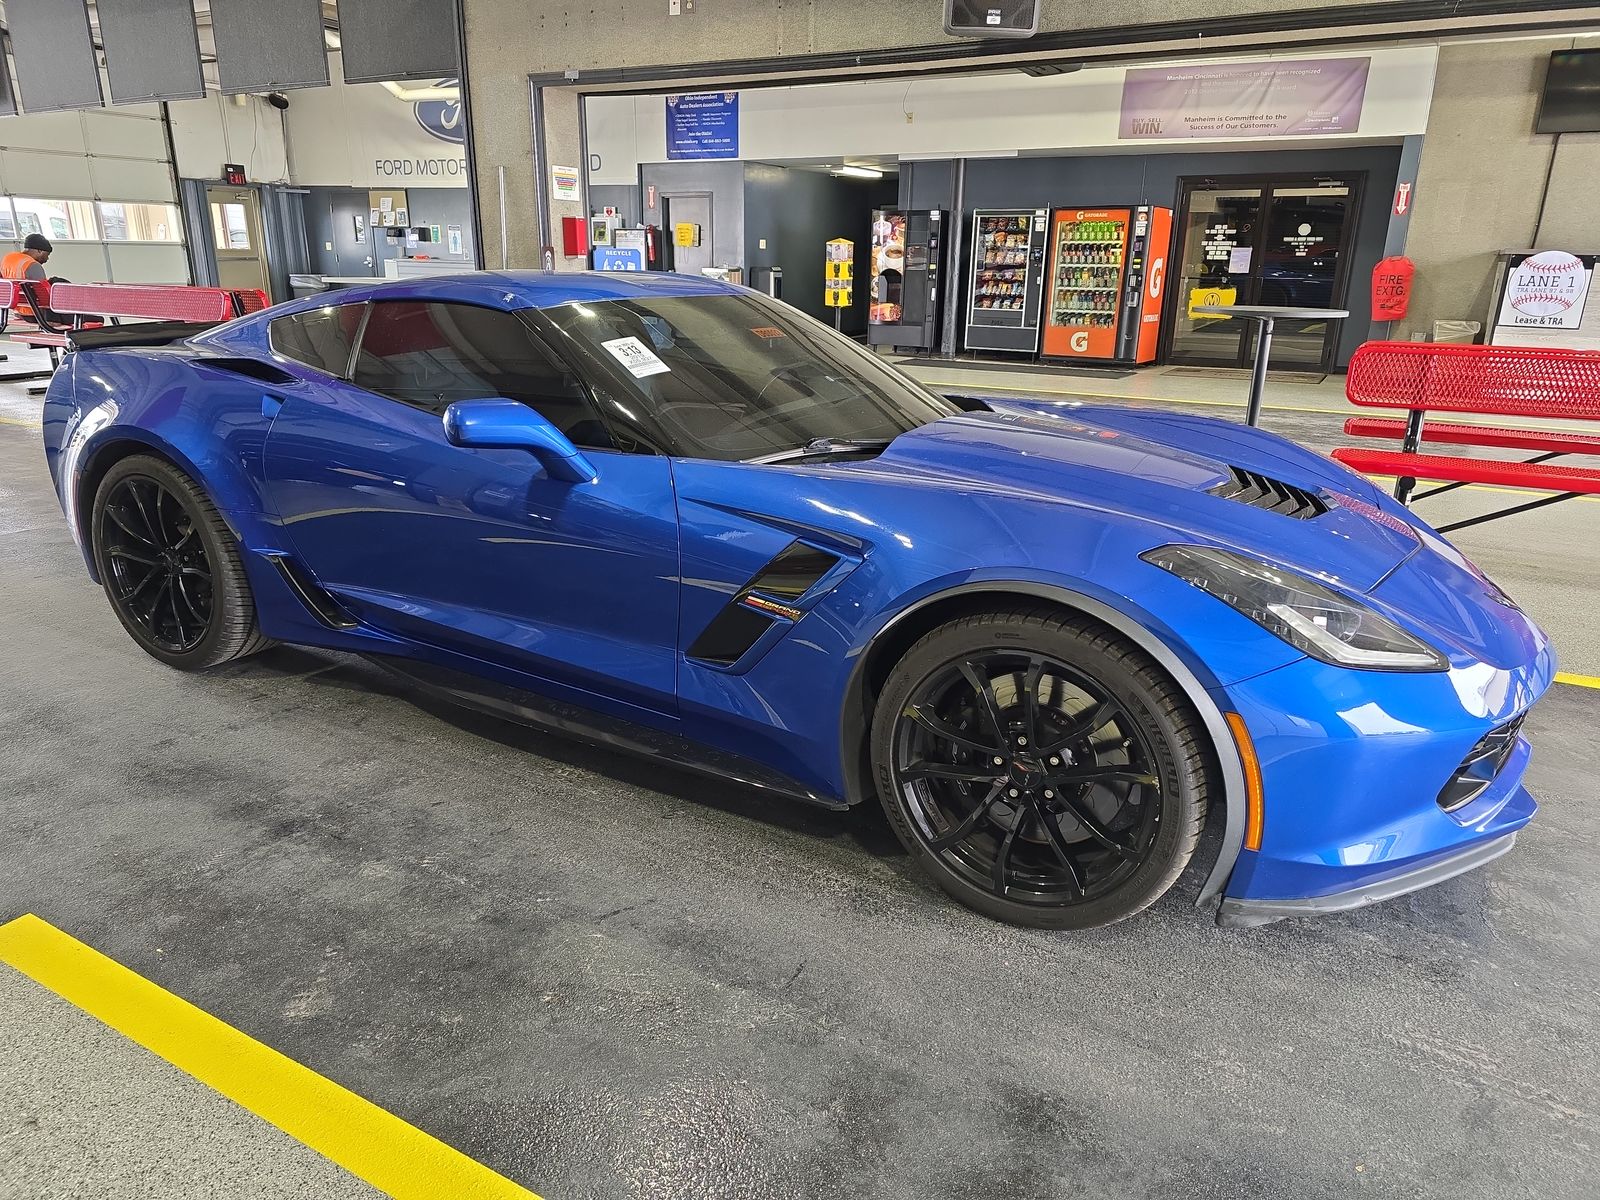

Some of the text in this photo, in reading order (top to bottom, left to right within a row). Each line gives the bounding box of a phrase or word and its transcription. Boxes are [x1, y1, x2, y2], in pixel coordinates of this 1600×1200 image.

[1290, 68, 1321, 76] recognized
[1224, 114, 1264, 122] Committed
[1132, 122, 1163, 135] WIN.
[375, 159, 413, 176] FORD
[230, 173, 246, 185] EXIT
[1076, 211, 1084, 220] G
[1149, 257, 1164, 299] G
[1379, 274, 1404, 285] FIRE
[1517, 275, 1575, 288] LANE 1
[1376, 285, 1406, 296] EXTG.
[1514, 315, 1563, 326] Lease & TRA
[1070, 331, 1089, 353] G
[764, 601, 801, 615] GRAND
